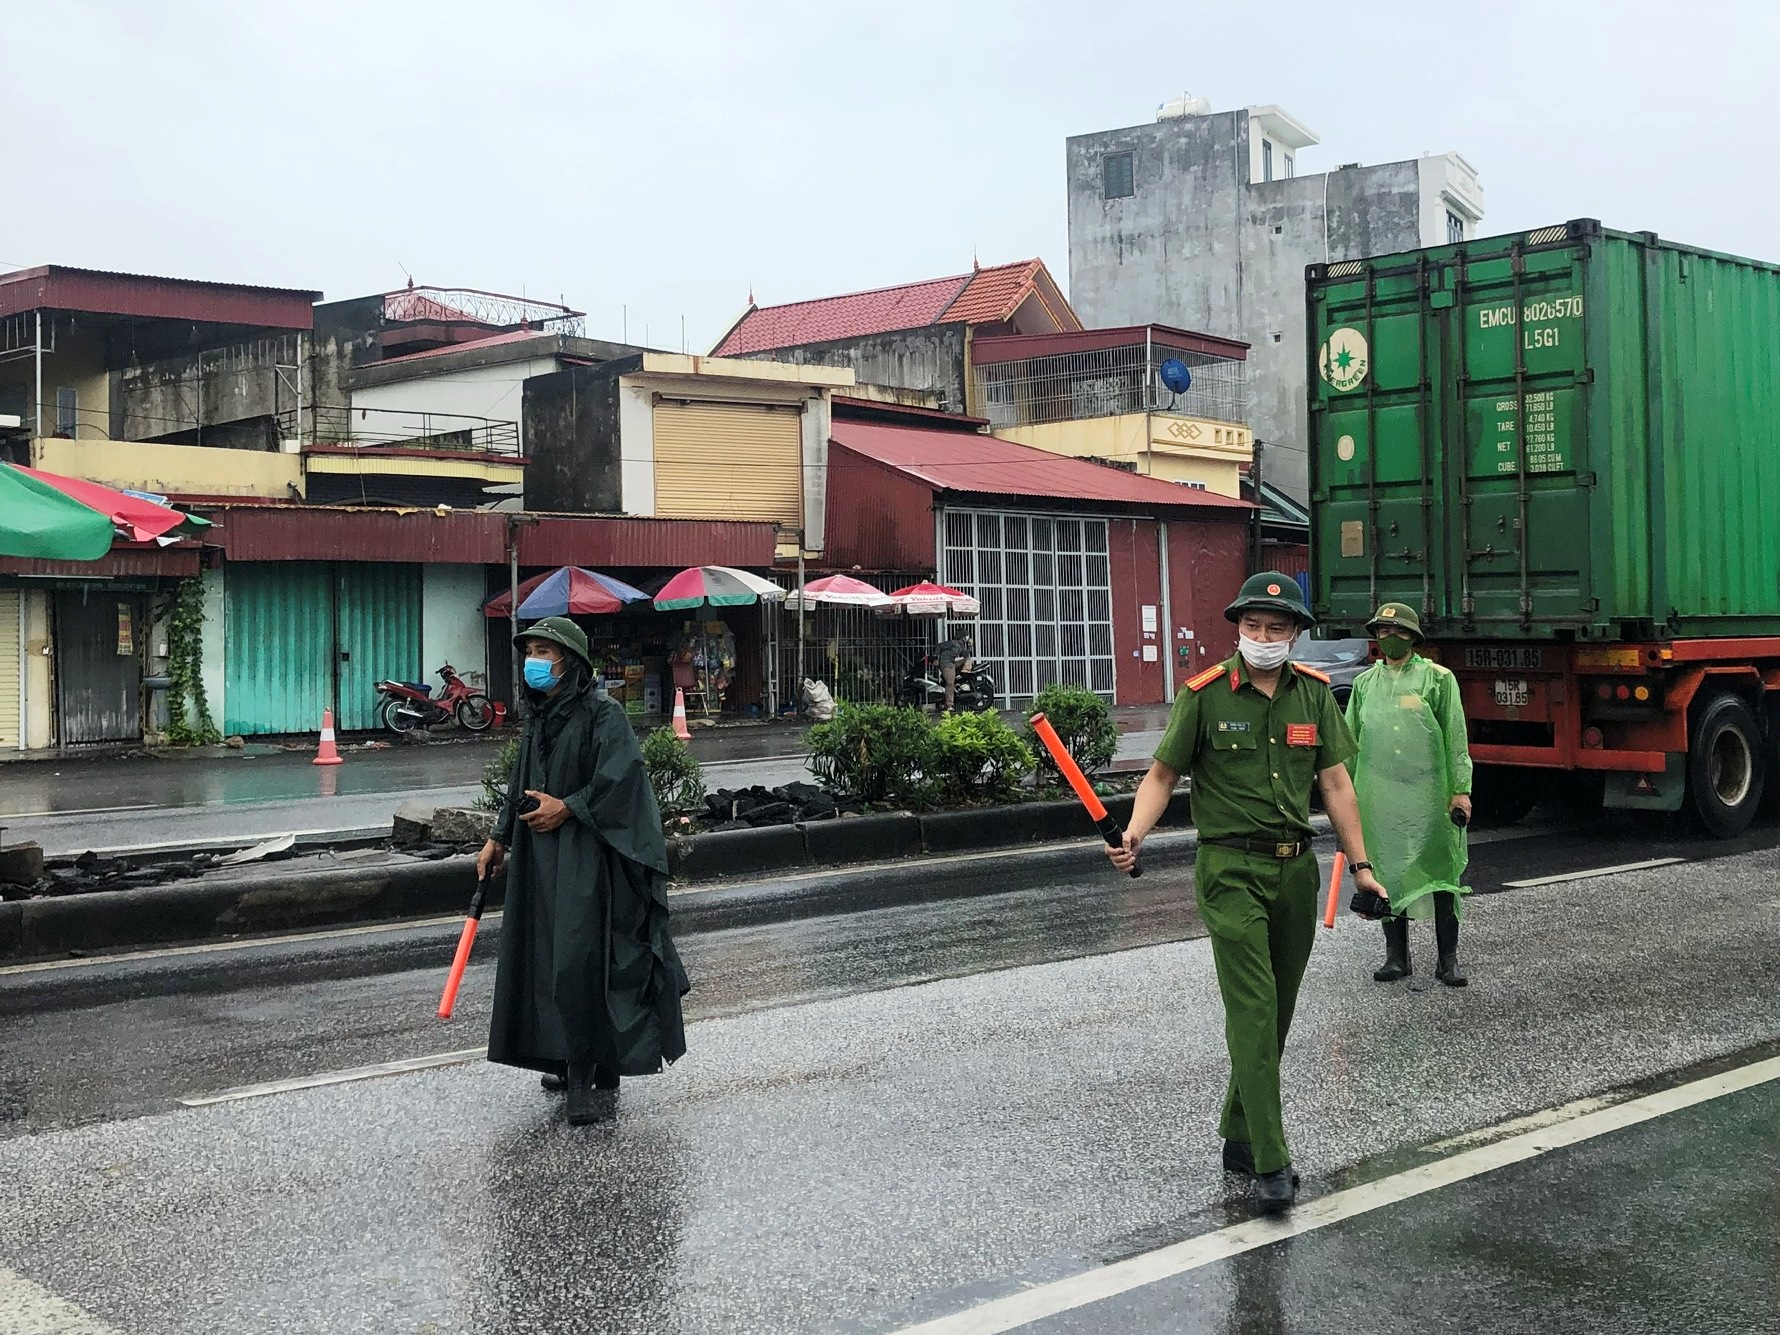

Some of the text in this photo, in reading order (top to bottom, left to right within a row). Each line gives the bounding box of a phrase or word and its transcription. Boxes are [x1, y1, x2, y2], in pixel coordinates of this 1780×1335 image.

[1480, 296, 1583, 328] EMCU 8026570
[1524, 328, 1559, 349] L5G1
[1323, 359, 1366, 387] ERGREEN
[1546, 392, 1554, 401] KG
[1496, 401, 1518, 412] GROSS
[1546, 402, 1554, 410] LB
[1546, 413, 1554, 421] KG
[1497, 421, 1515, 431] TARE
[1546, 422, 1555, 431] LB
[1547, 433, 1555, 442] KG
[1497, 441, 1511, 452] NET
[1547, 442, 1555, 451] LB
[1497, 461, 1516, 472] CUBE
[1468, 648, 1540, 668] 15R-031.85
[1501, 680, 1520, 692] 15R
[1496, 692, 1528, 705] 031.85
